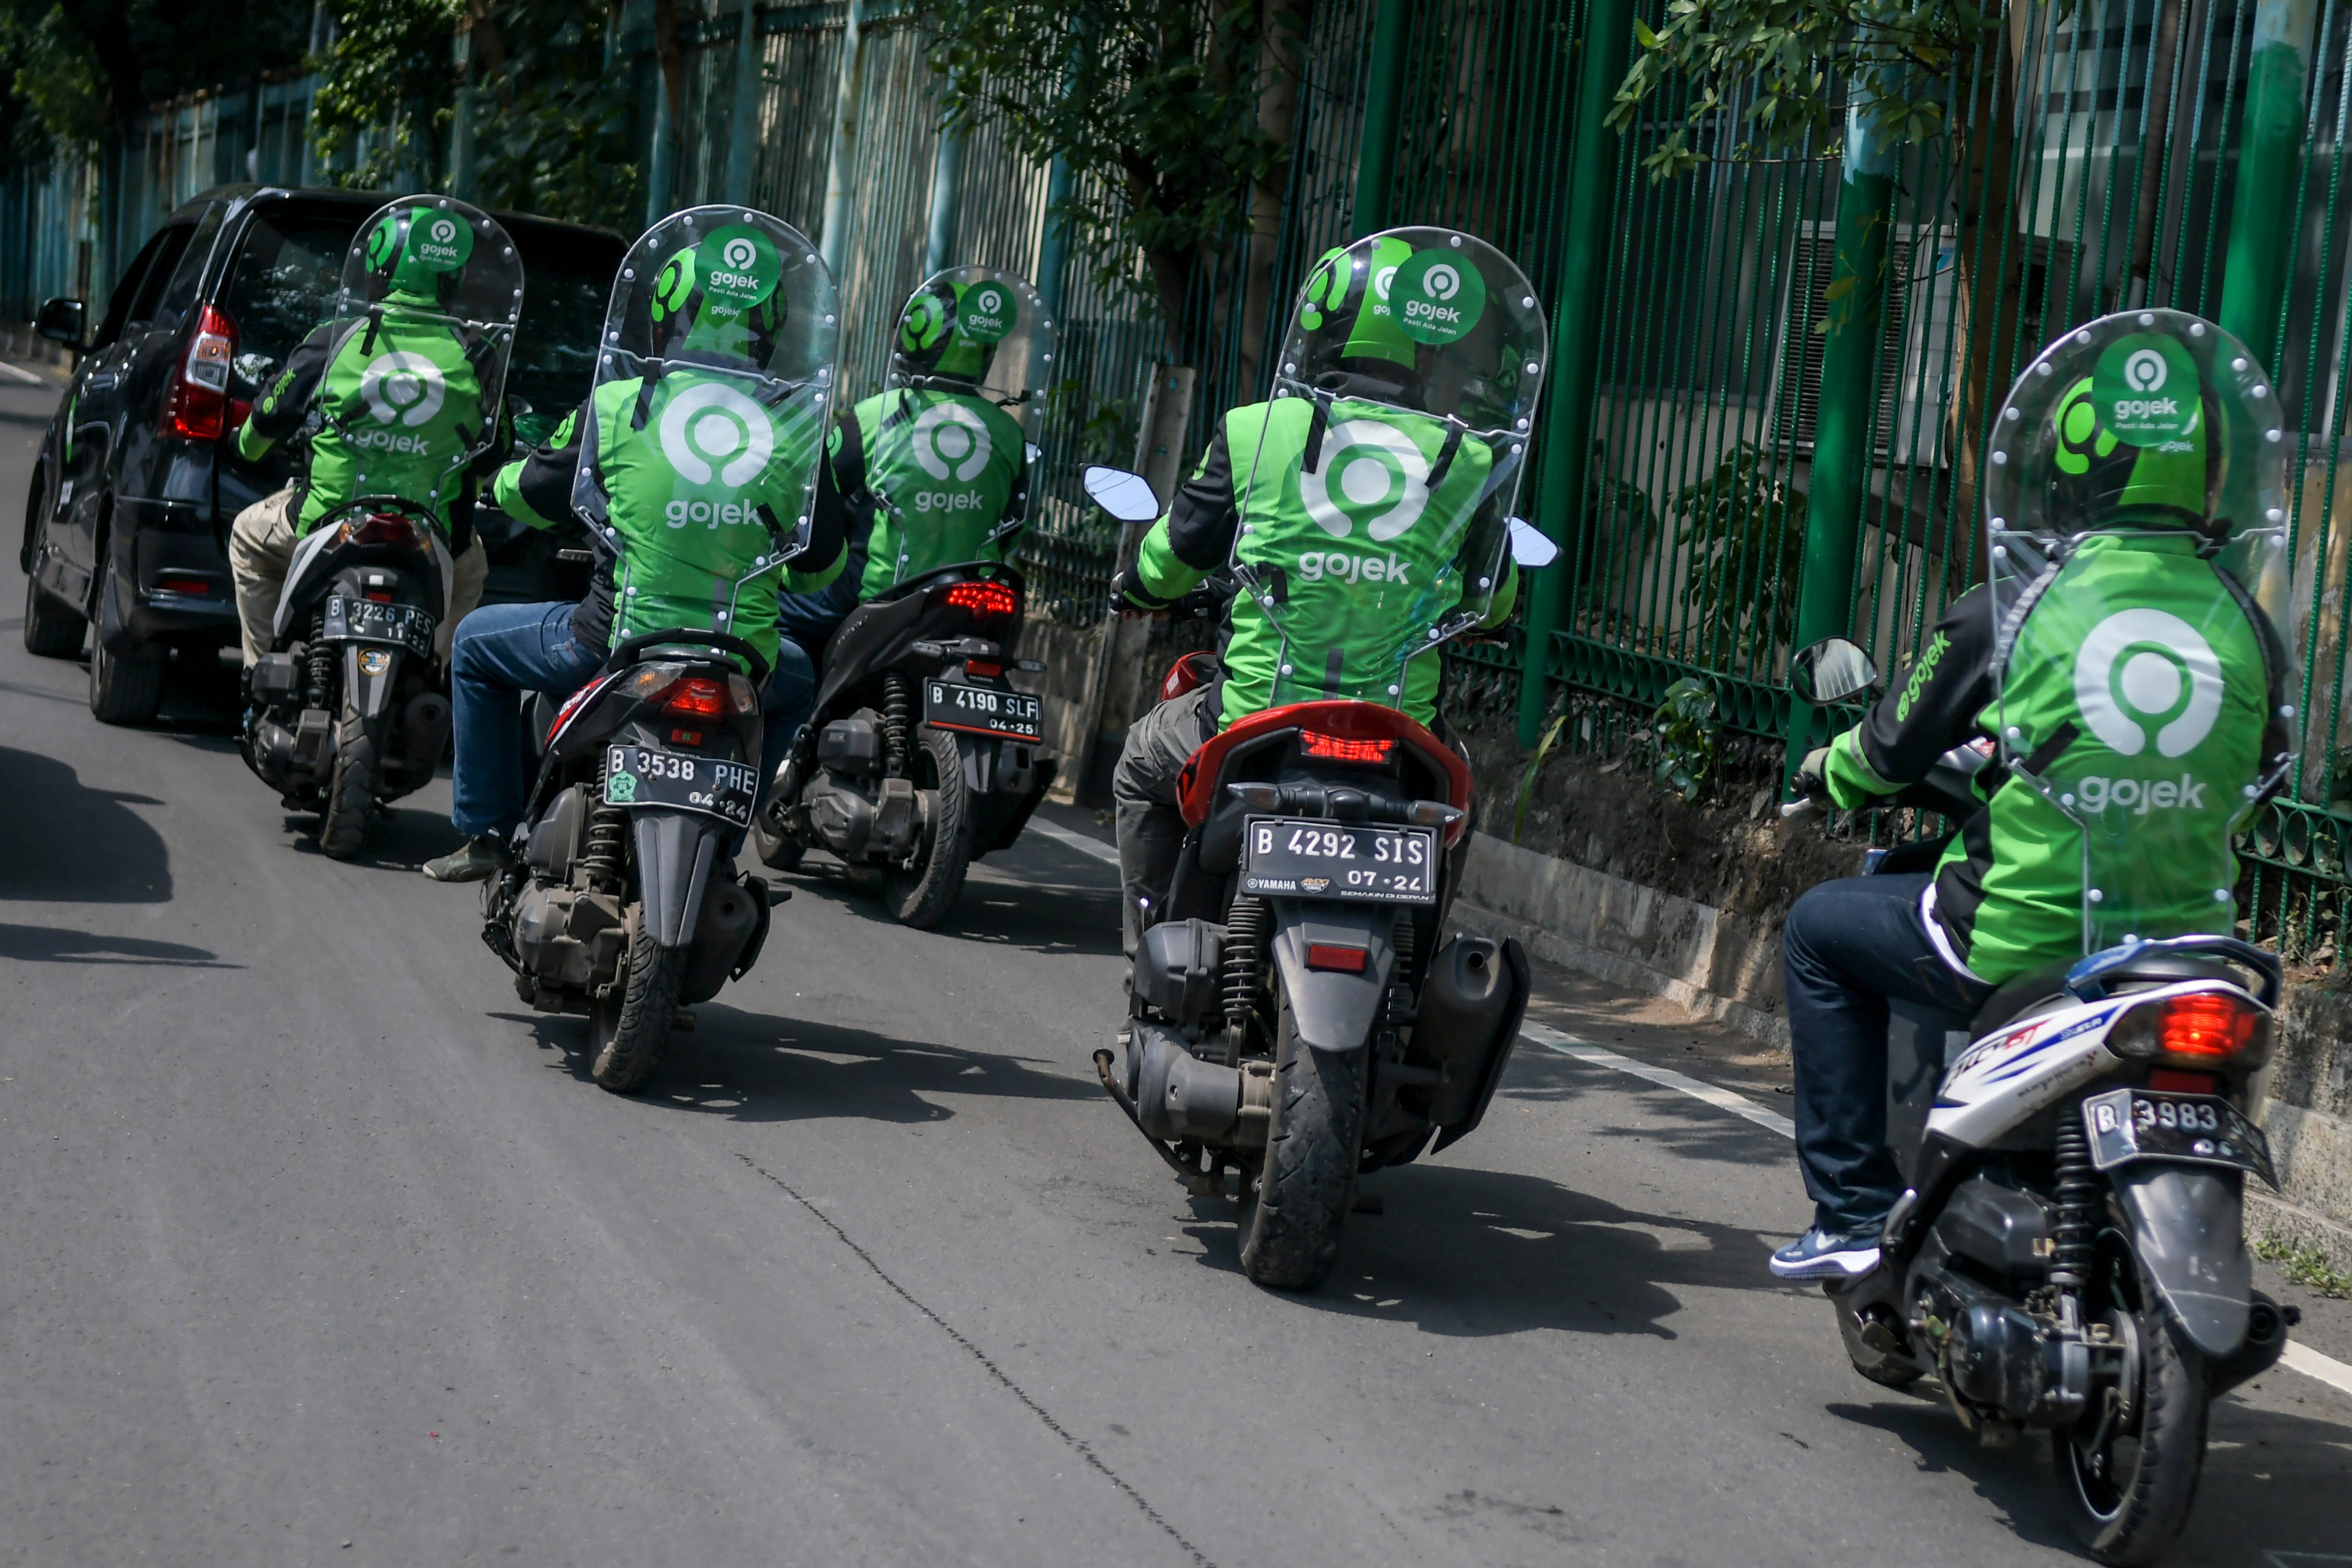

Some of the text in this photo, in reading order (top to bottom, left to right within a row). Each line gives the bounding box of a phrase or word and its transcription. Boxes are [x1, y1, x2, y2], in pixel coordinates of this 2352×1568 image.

[421, 243, 457, 256] gojek
[710, 271, 759, 289] gojek
[711, 306, 740, 317] gojek
[969, 315, 1003, 328] gojek
[1374, 305, 1391, 316] goj
[1406, 300, 1461, 323] gojek
[1404, 317, 1421, 326] Pasti
[1438, 326, 1456, 335] Jalan
[2114, 397, 2178, 419] gojek
[355, 427, 430, 456] gojek
[666, 499, 763, 529] gojek
[915, 489, 984, 513] gojek
[1299, 551, 1412, 584] gojek
[330, 599, 431, 635] B 3226 PES
[1908, 630, 1952, 703] gojek
[933, 686, 1036, 717] B 4190 SLF
[611, 750, 755, 795] B 3538 PHE
[2079, 773, 2207, 814] gojek
[1258, 828, 1423, 864] B 4292 SIS
[1258, 880, 1296, 891] YAMAHA
[2097, 1099, 2219, 1134] B 3983
